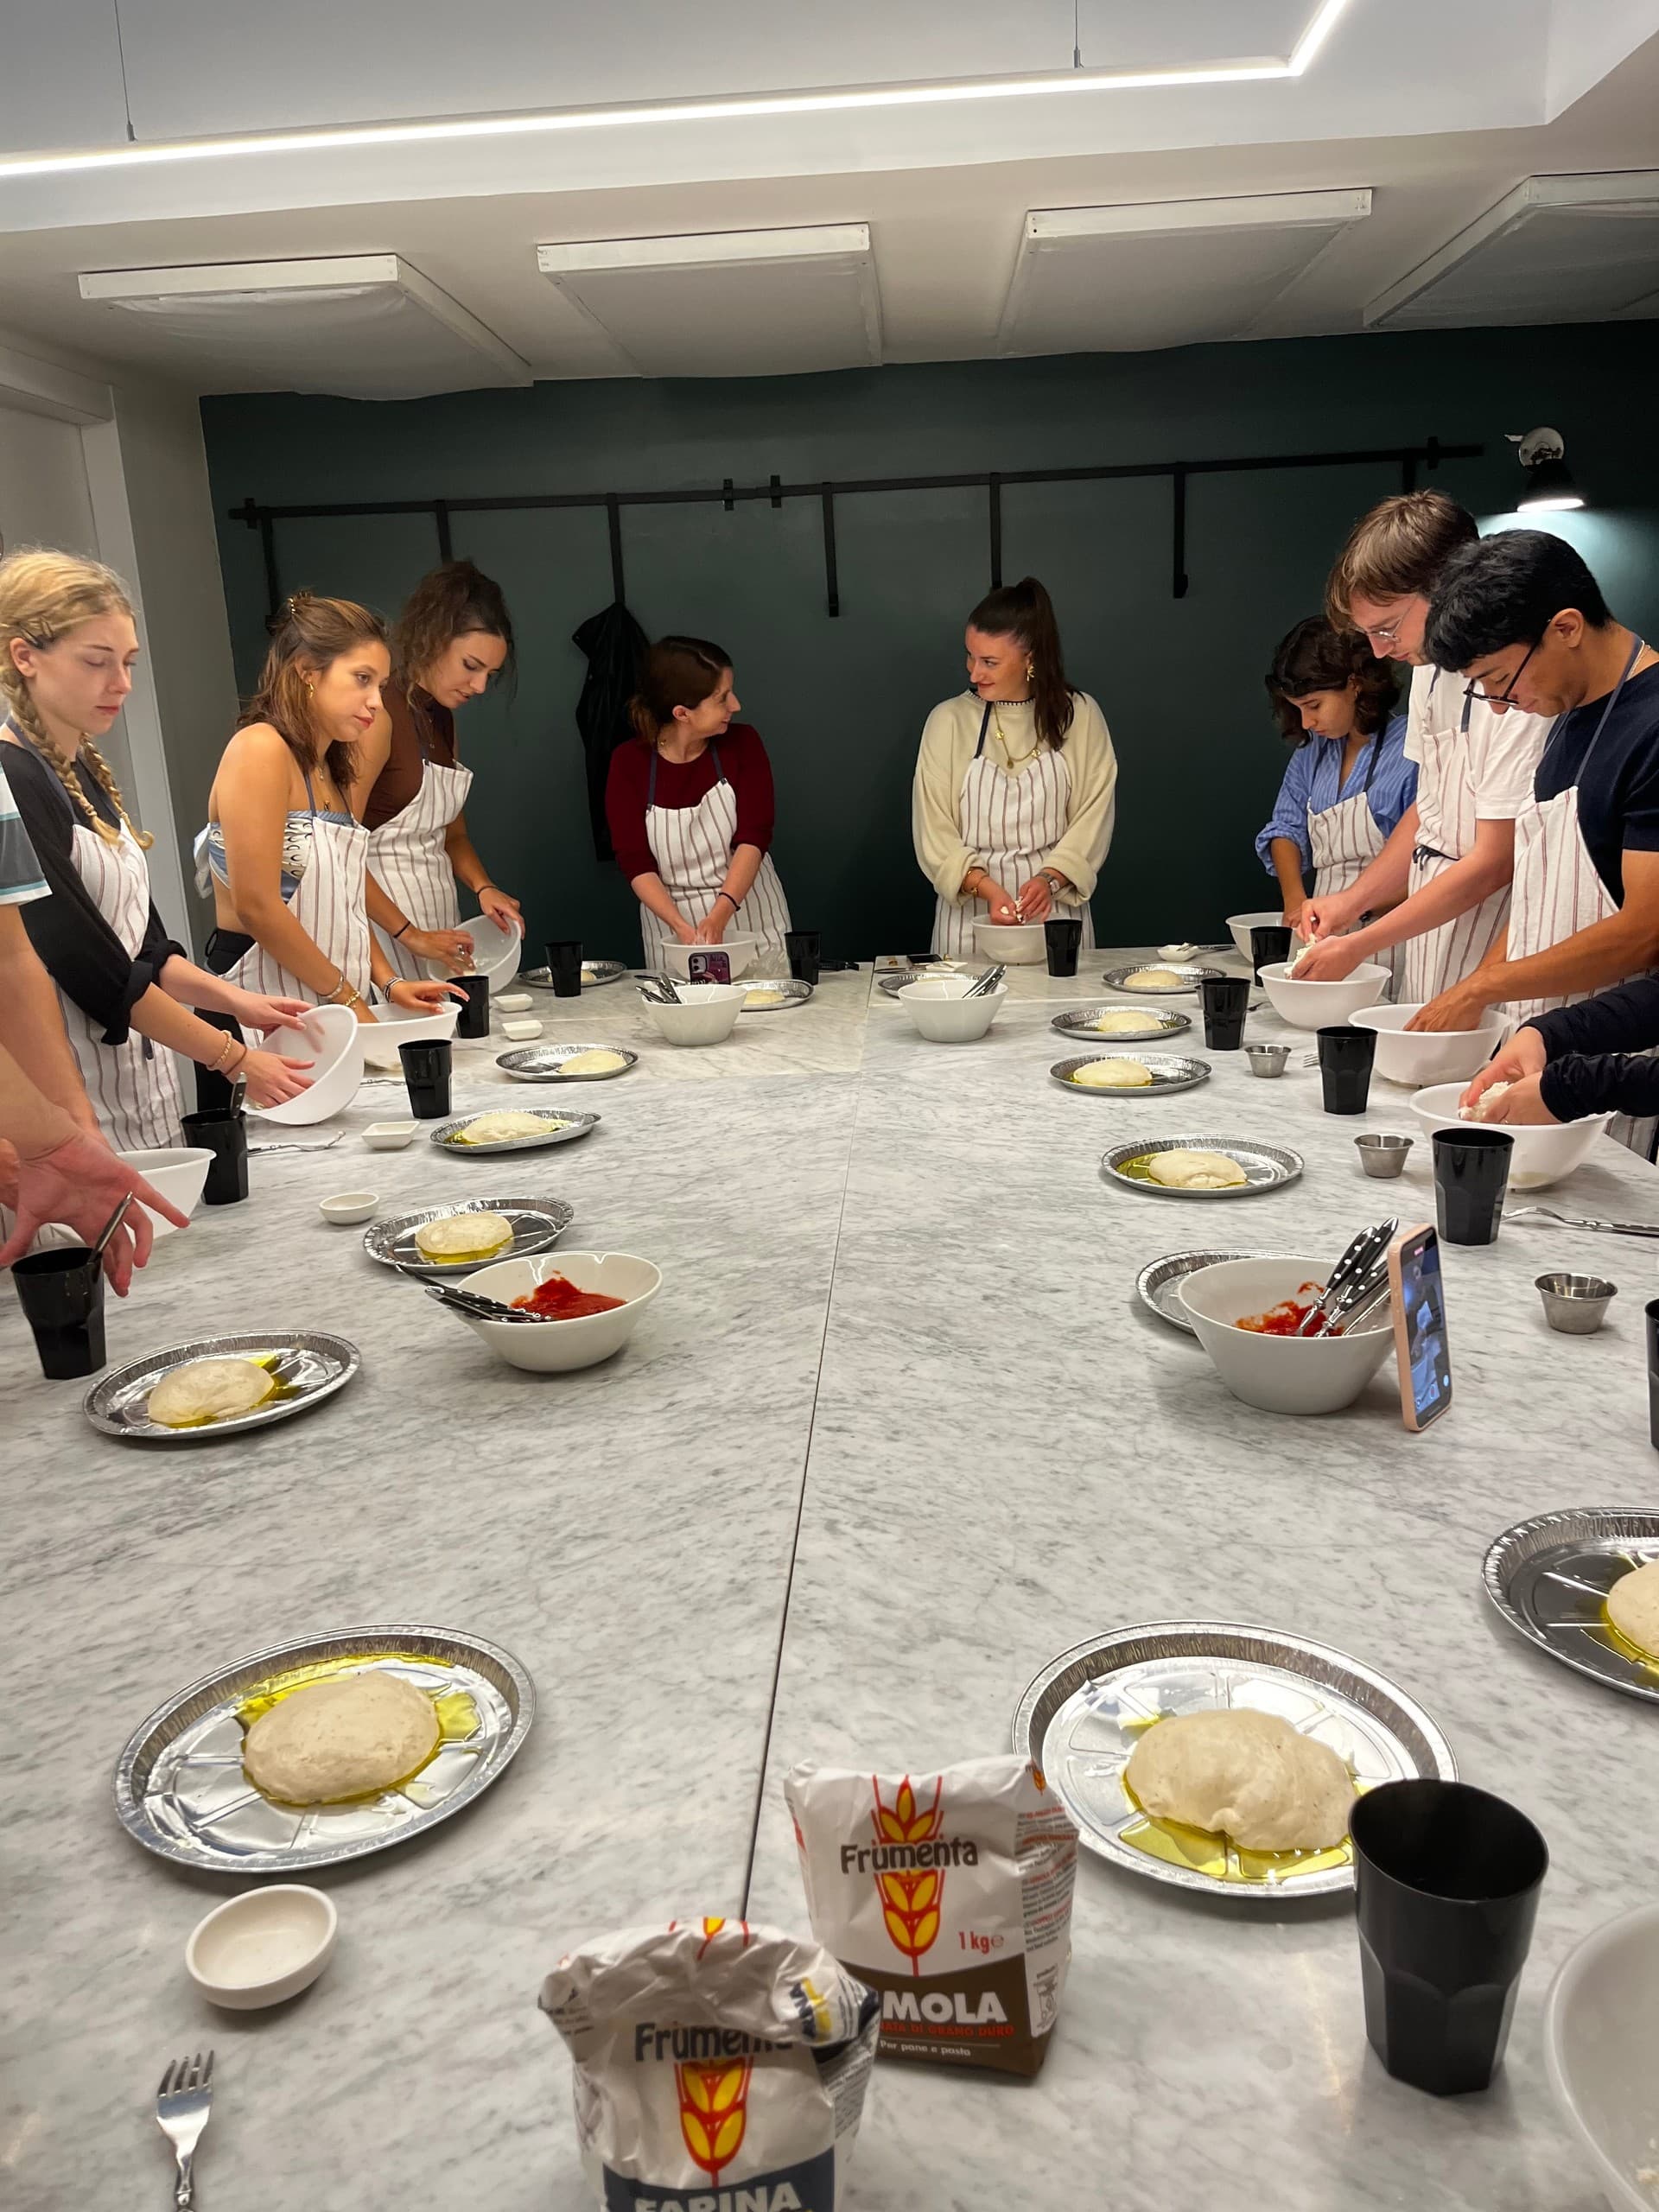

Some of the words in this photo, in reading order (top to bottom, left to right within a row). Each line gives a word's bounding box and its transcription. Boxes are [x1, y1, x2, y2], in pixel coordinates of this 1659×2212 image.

[841, 1836, 978, 1874] Frumenta
[959, 1932, 966, 1949] 1
[882, 1990, 1007, 2024] MOLA
[635, 2023, 793, 2062] Frumen
[912, 2024, 923, 2033] DI
[929, 2024, 974, 2037] GRANO
[978, 2024, 1014, 2037] DURO
[880, 2040, 898, 2050] Per
[901, 2043, 928, 2053] pane
[941, 2044, 971, 2056] pasta
